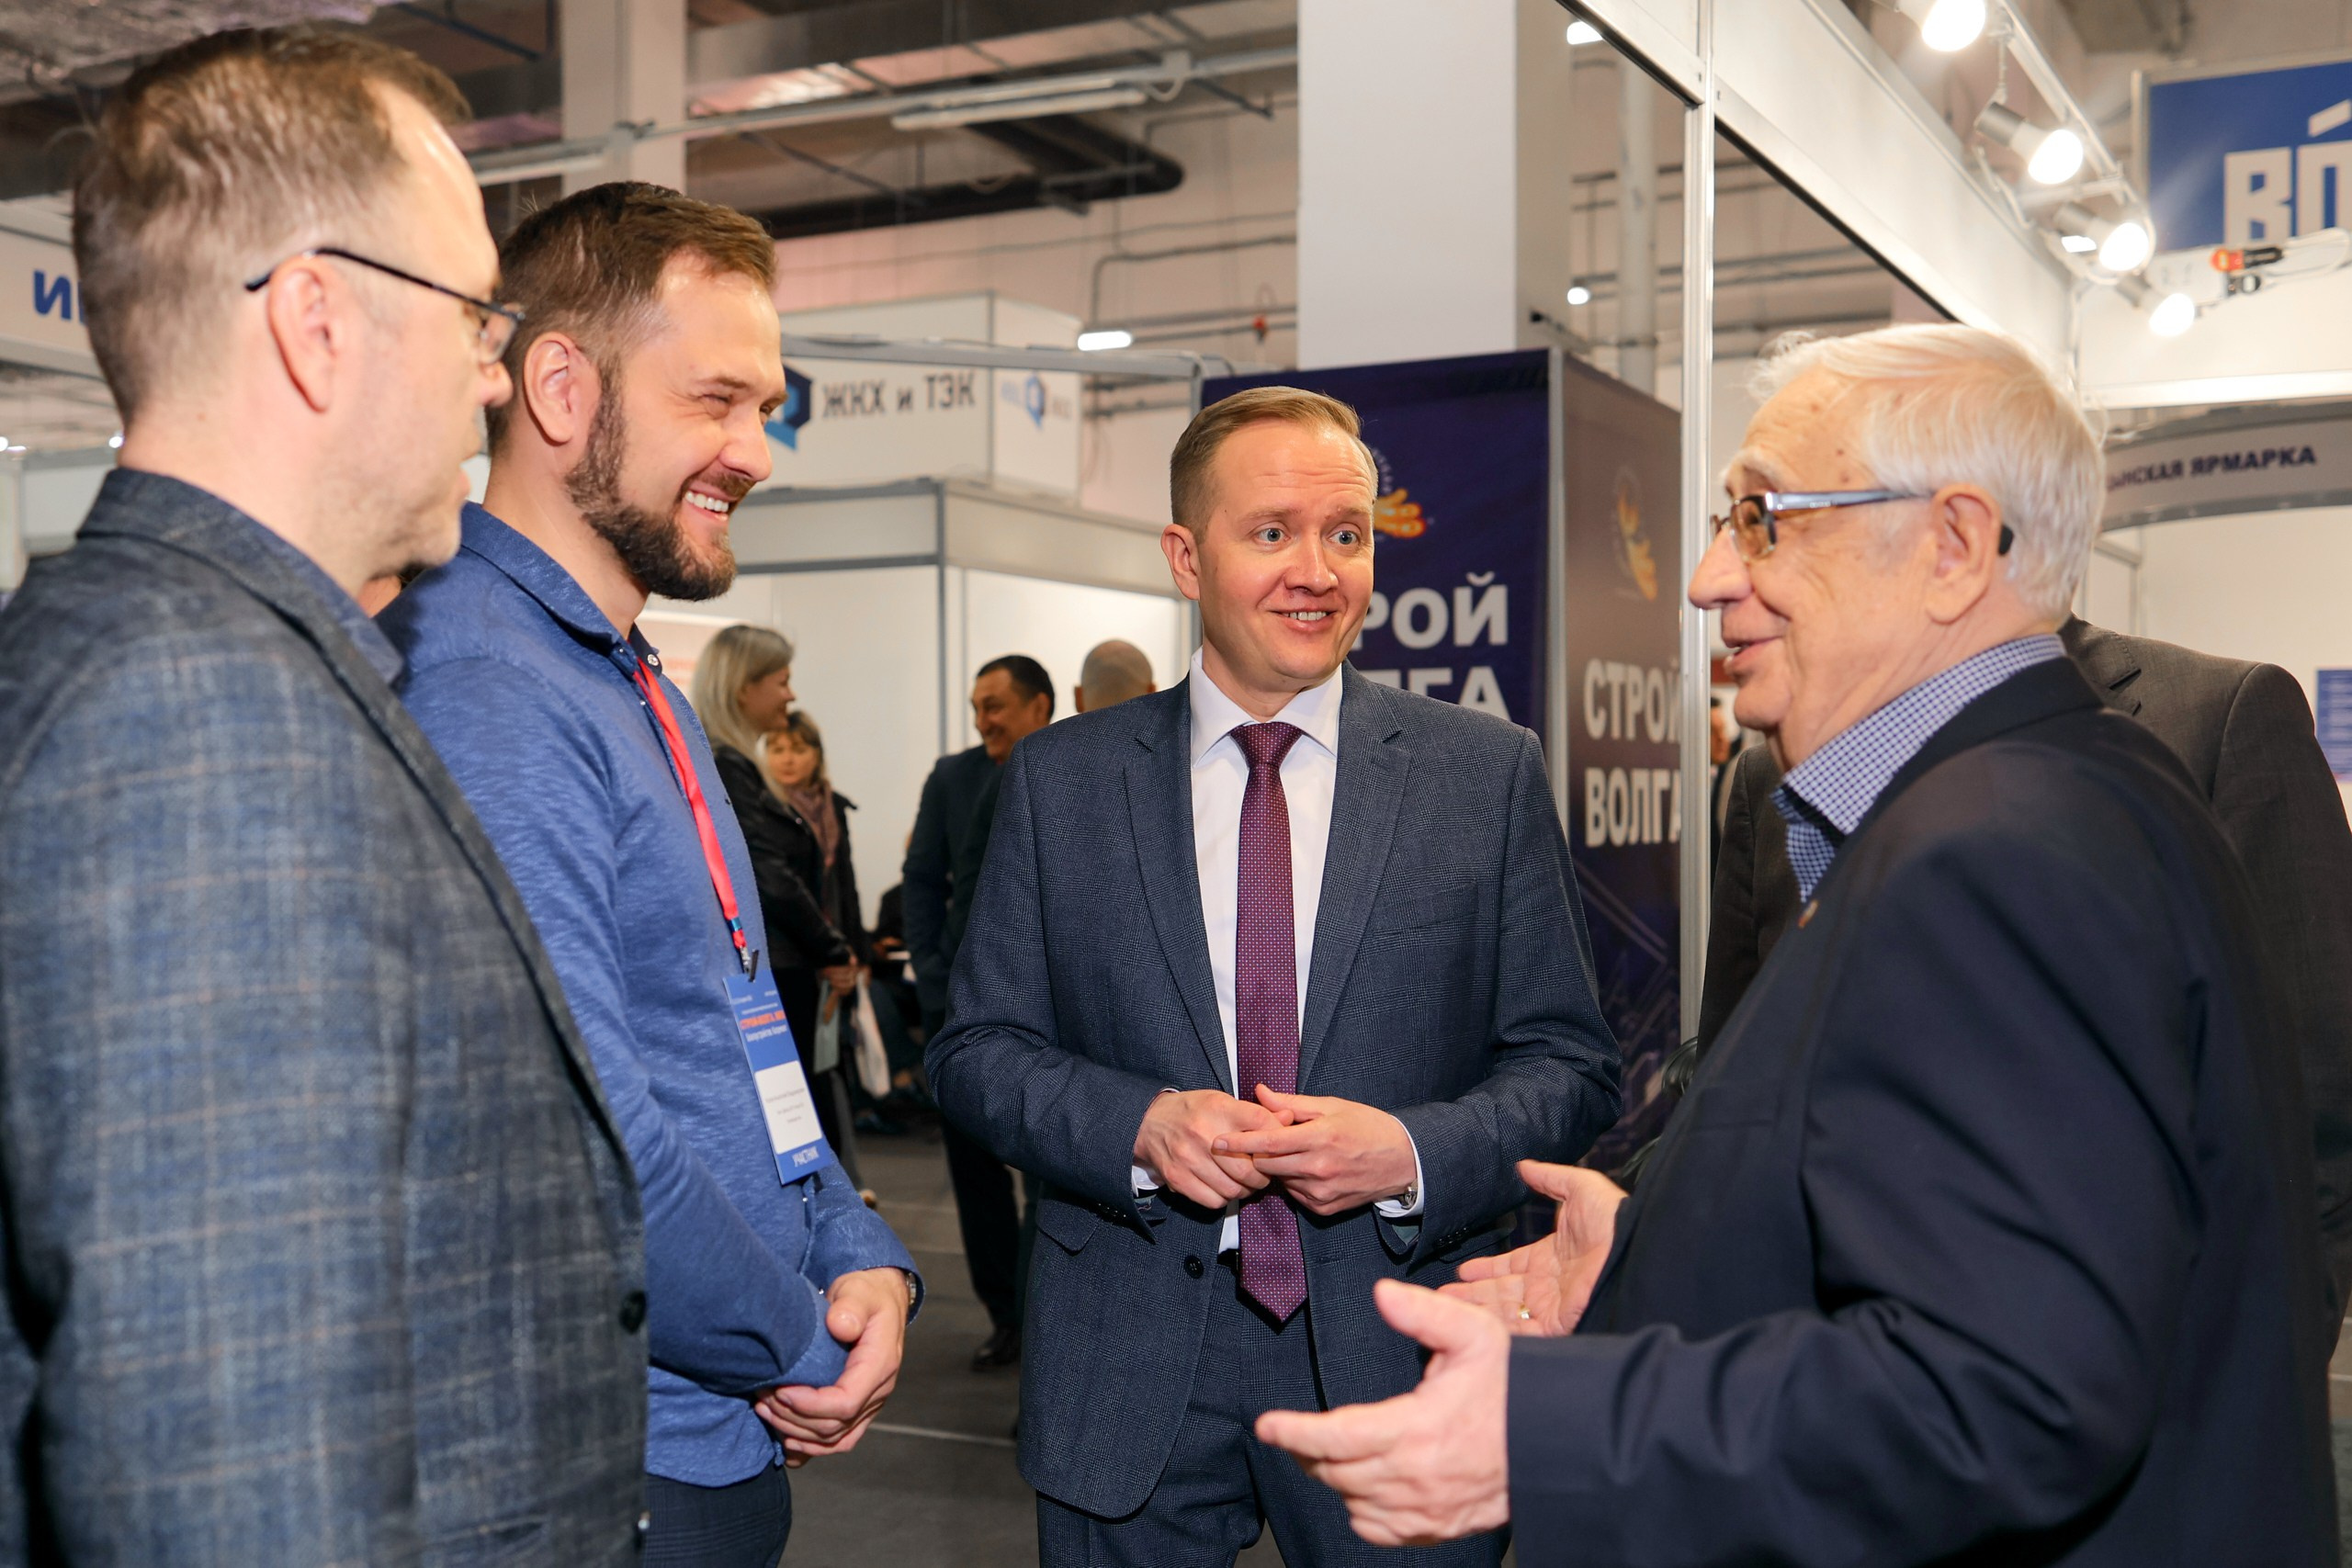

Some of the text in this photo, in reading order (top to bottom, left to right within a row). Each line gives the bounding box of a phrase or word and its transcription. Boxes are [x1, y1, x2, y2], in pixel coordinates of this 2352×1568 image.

[823, 380, 886, 418] ЖКХ
[897, 387, 913, 411] и
[924, 370, 976, 410] ТЭК
[2190, 445, 2317, 477] ЯРМАРКА
[1358, 665, 1512, 723] ГА
